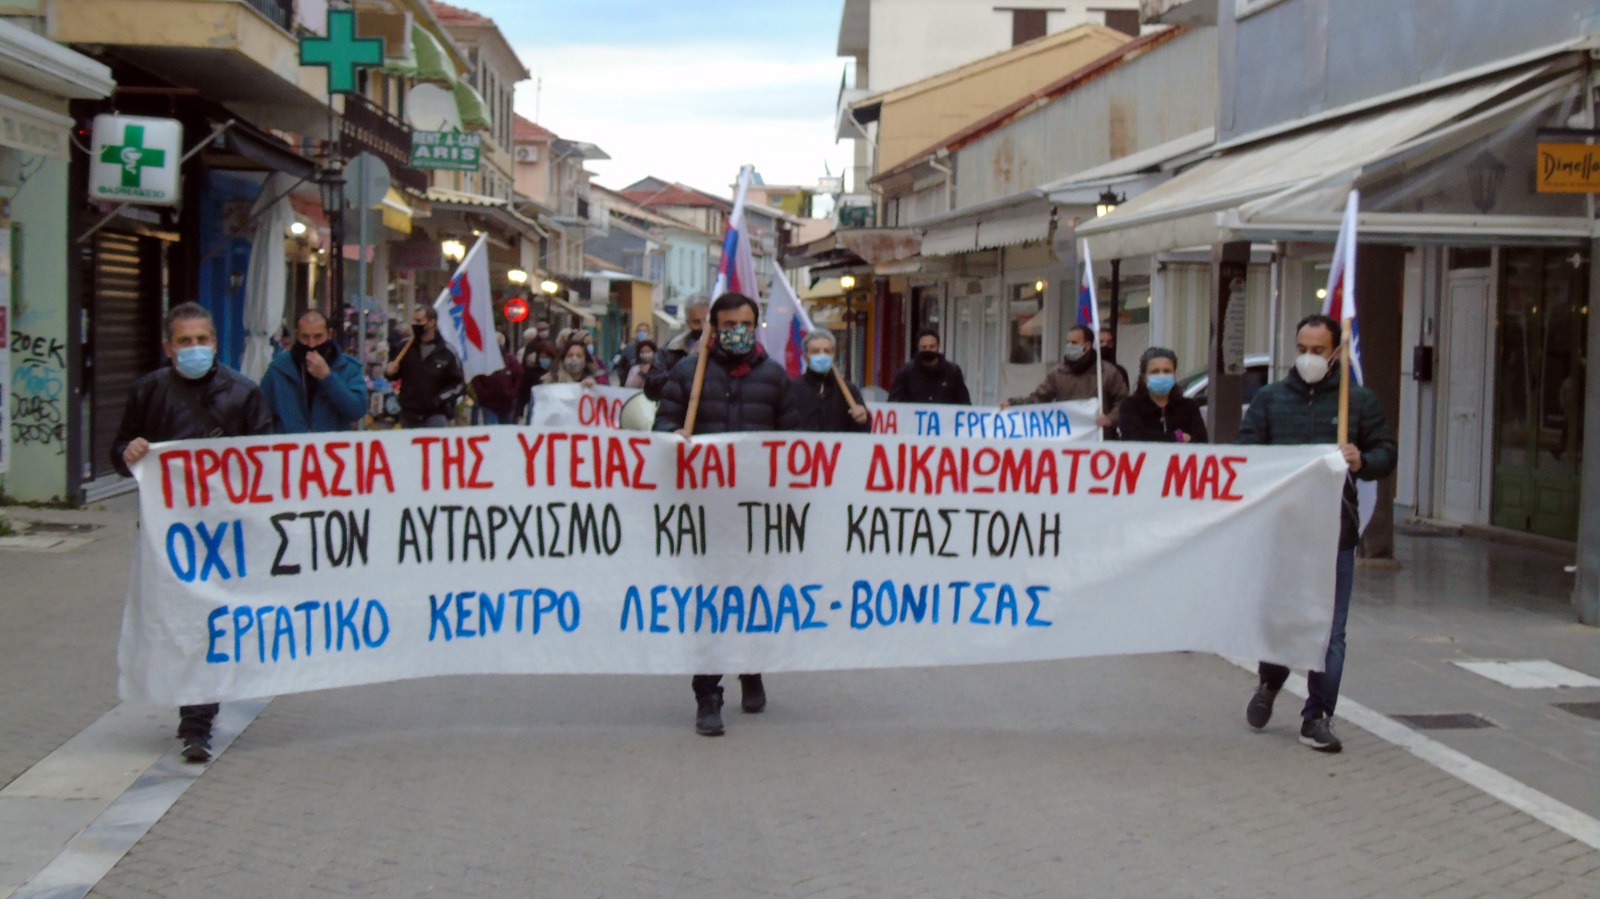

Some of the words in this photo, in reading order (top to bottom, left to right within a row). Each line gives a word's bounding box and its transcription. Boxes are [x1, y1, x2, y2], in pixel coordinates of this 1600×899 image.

[415, 145, 475, 160] ARIS
[914, 409, 941, 437] ΤΑ
[954, 409, 1072, 439] ΕΡΓΑΣΙΑΚΑ
[160, 440, 395, 509] ΠΡΟΣΤΑΣΙΑ
[411, 434, 494, 491] ΤΗΣ
[517, 432, 656, 491] ΥΓΕΙΑΣ
[676, 441, 736, 490] ΚΑΙ
[762, 440, 842, 488] ΤΩΝ
[865, 443, 1147, 496] ΔΙΚΑΙΩΜΑΤΩΝ
[1161, 453, 1248, 501] ΜΑΣ
[166, 519, 248, 583] ΟΧΙ
[270, 508, 370, 576] ΣΤΟΝ
[398, 502, 622, 564] ΑΥΤΑΡΧΙΣΜΟ
[654, 503, 707, 556] ΚΑΙ
[738, 502, 811, 555] ΤΗΝ
[847, 504, 1061, 558] ΚΑΤΑΣΤΟΛΗ
[206, 598, 391, 664] ΕΡΓΑΤΙΚΟ
[428, 587, 581, 642] ΚΕΝΤΡΟ
